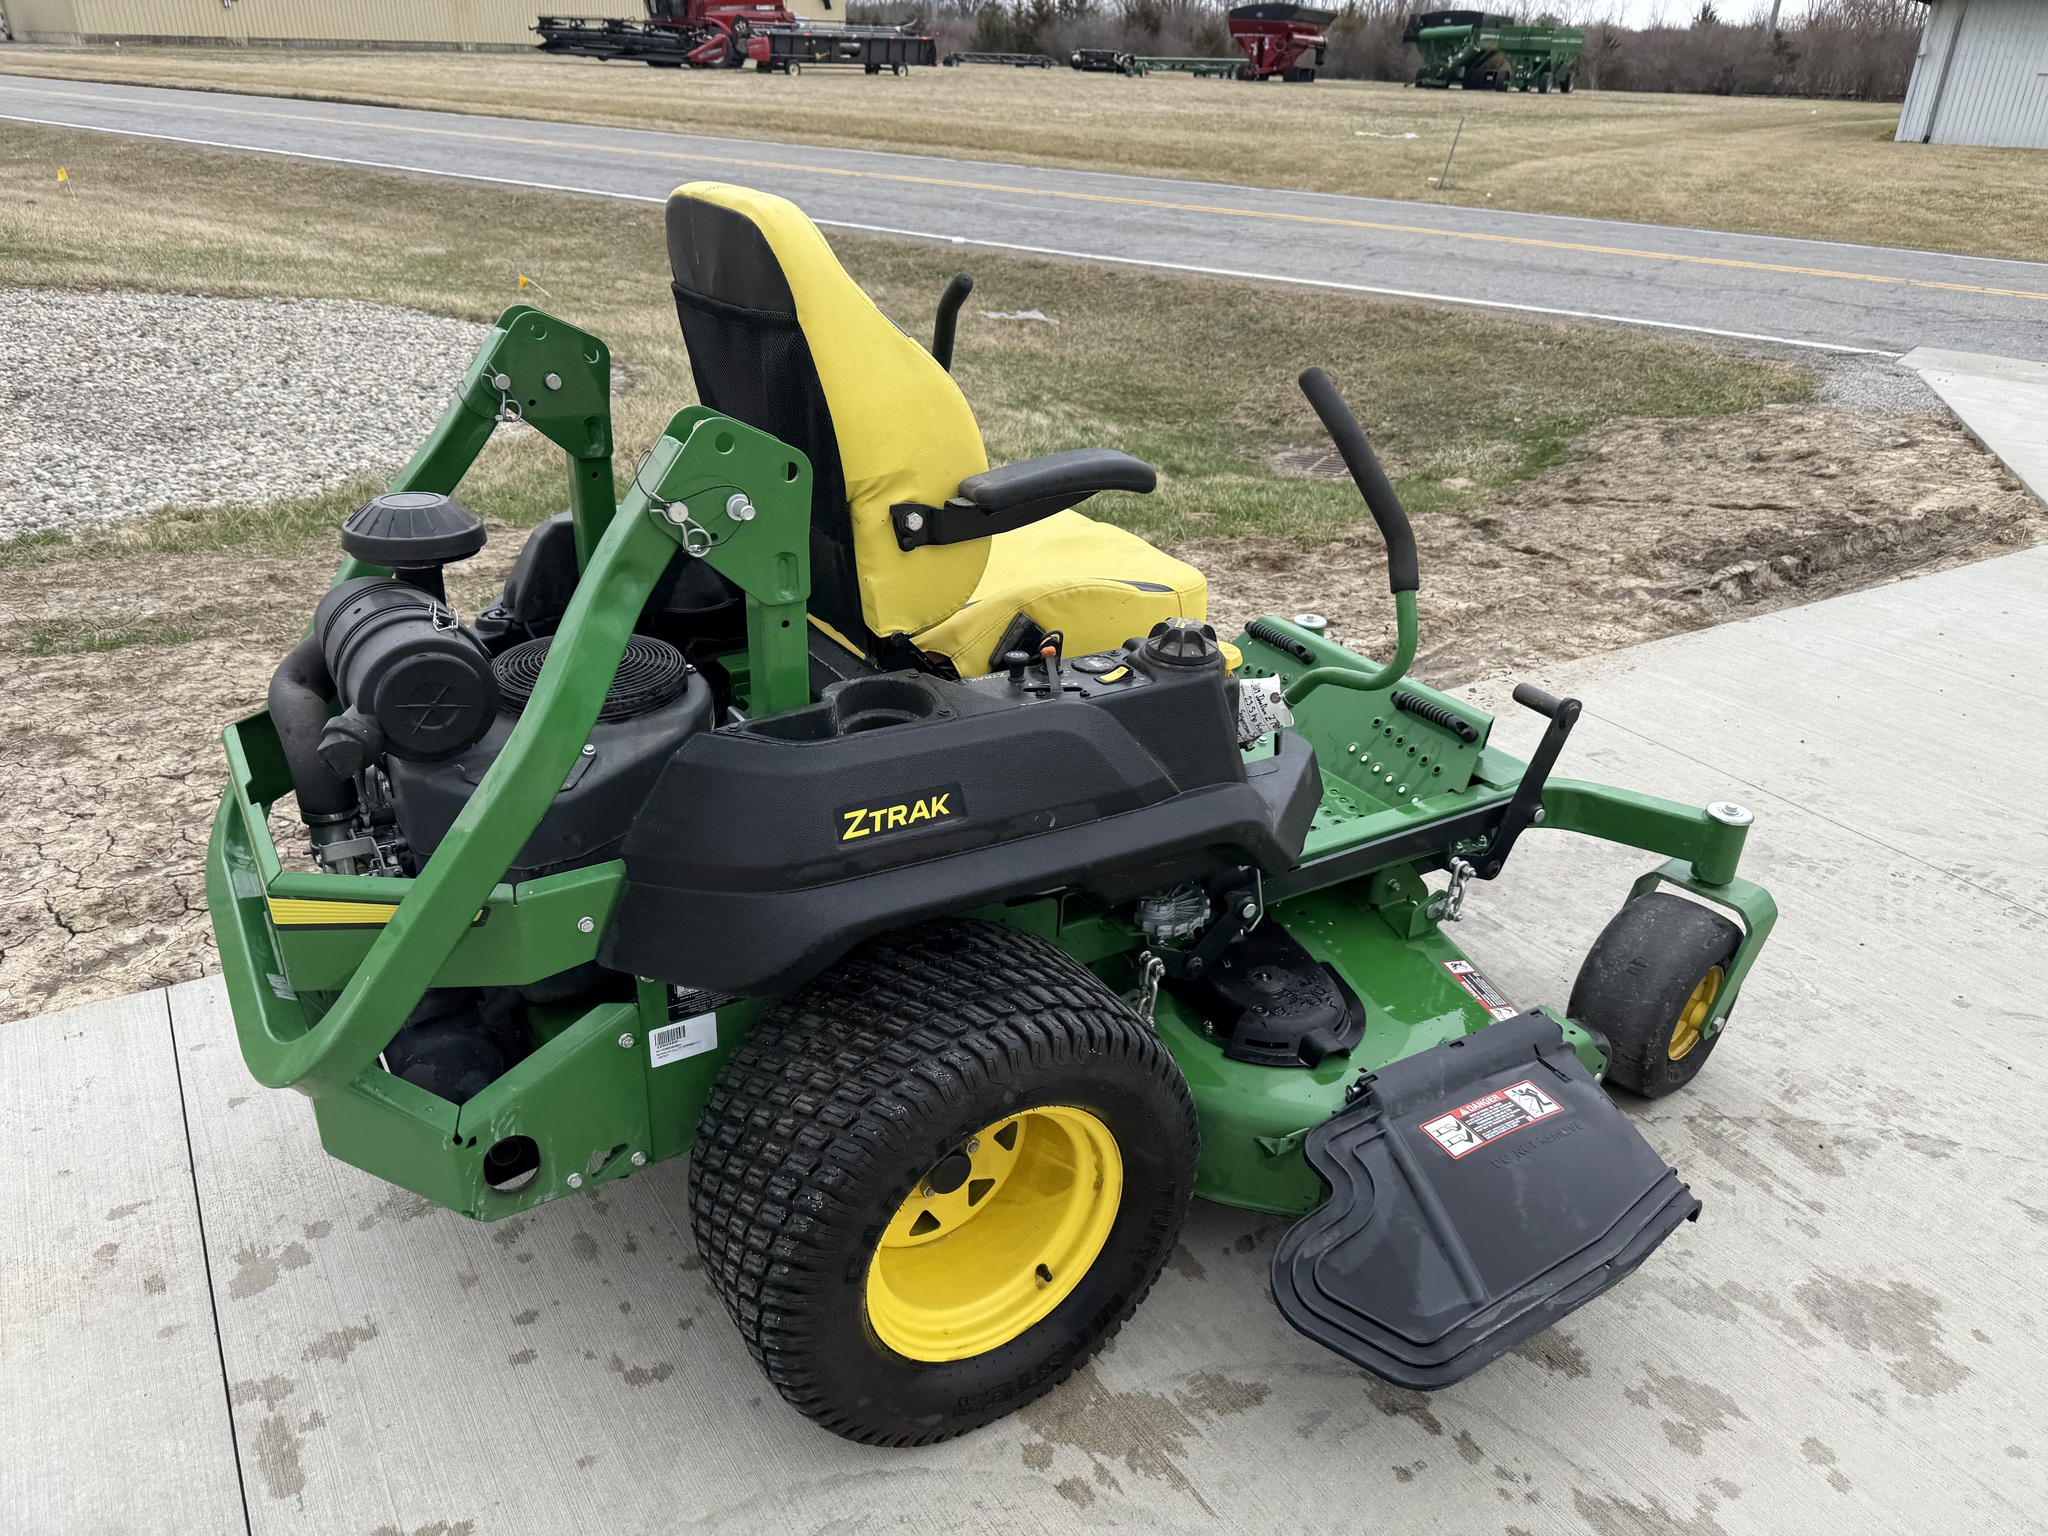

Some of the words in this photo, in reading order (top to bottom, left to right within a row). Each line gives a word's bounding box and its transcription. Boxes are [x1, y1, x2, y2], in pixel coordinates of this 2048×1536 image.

[842, 792, 950, 841] ZTRAK
[1468, 1094, 1502, 1112] DANGER
[1490, 1154, 1511, 1169] DO
[1512, 1141, 1538, 1158] NOT
[1536, 1121, 1584, 1145] REMOVE
